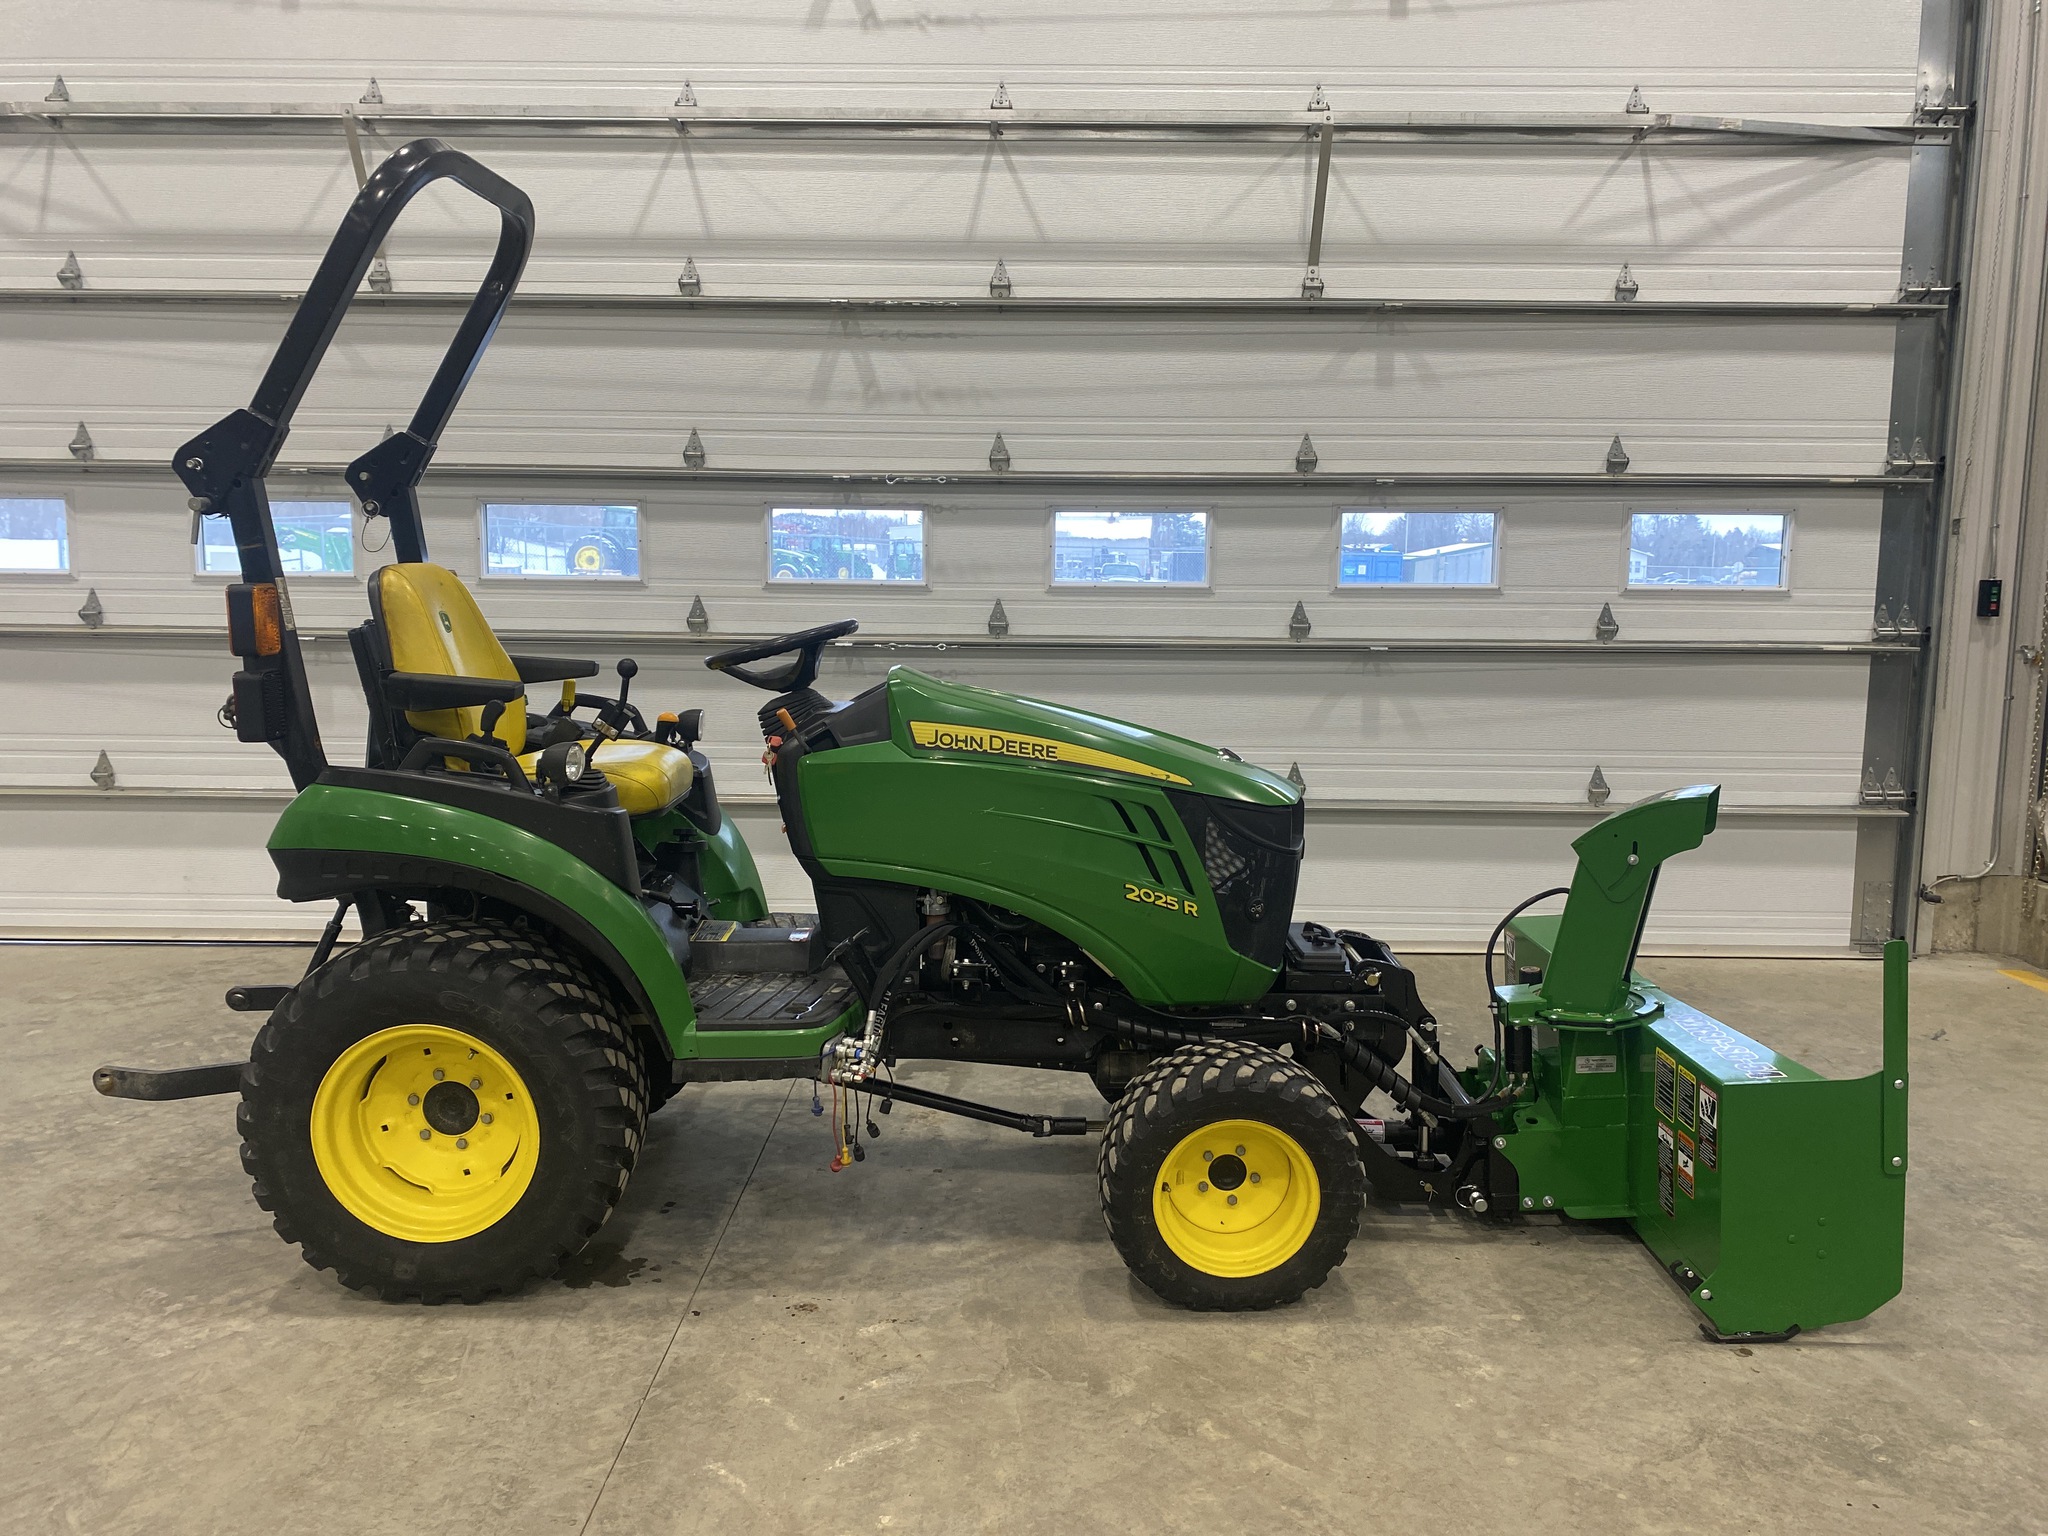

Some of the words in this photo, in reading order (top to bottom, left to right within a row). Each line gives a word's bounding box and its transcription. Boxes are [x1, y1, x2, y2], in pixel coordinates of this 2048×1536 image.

[926, 729, 984, 750] JOHN
[988, 733, 1058, 760] DEERE
[1124, 883, 1180, 911] 2025
[1183, 900, 1199, 918] R
